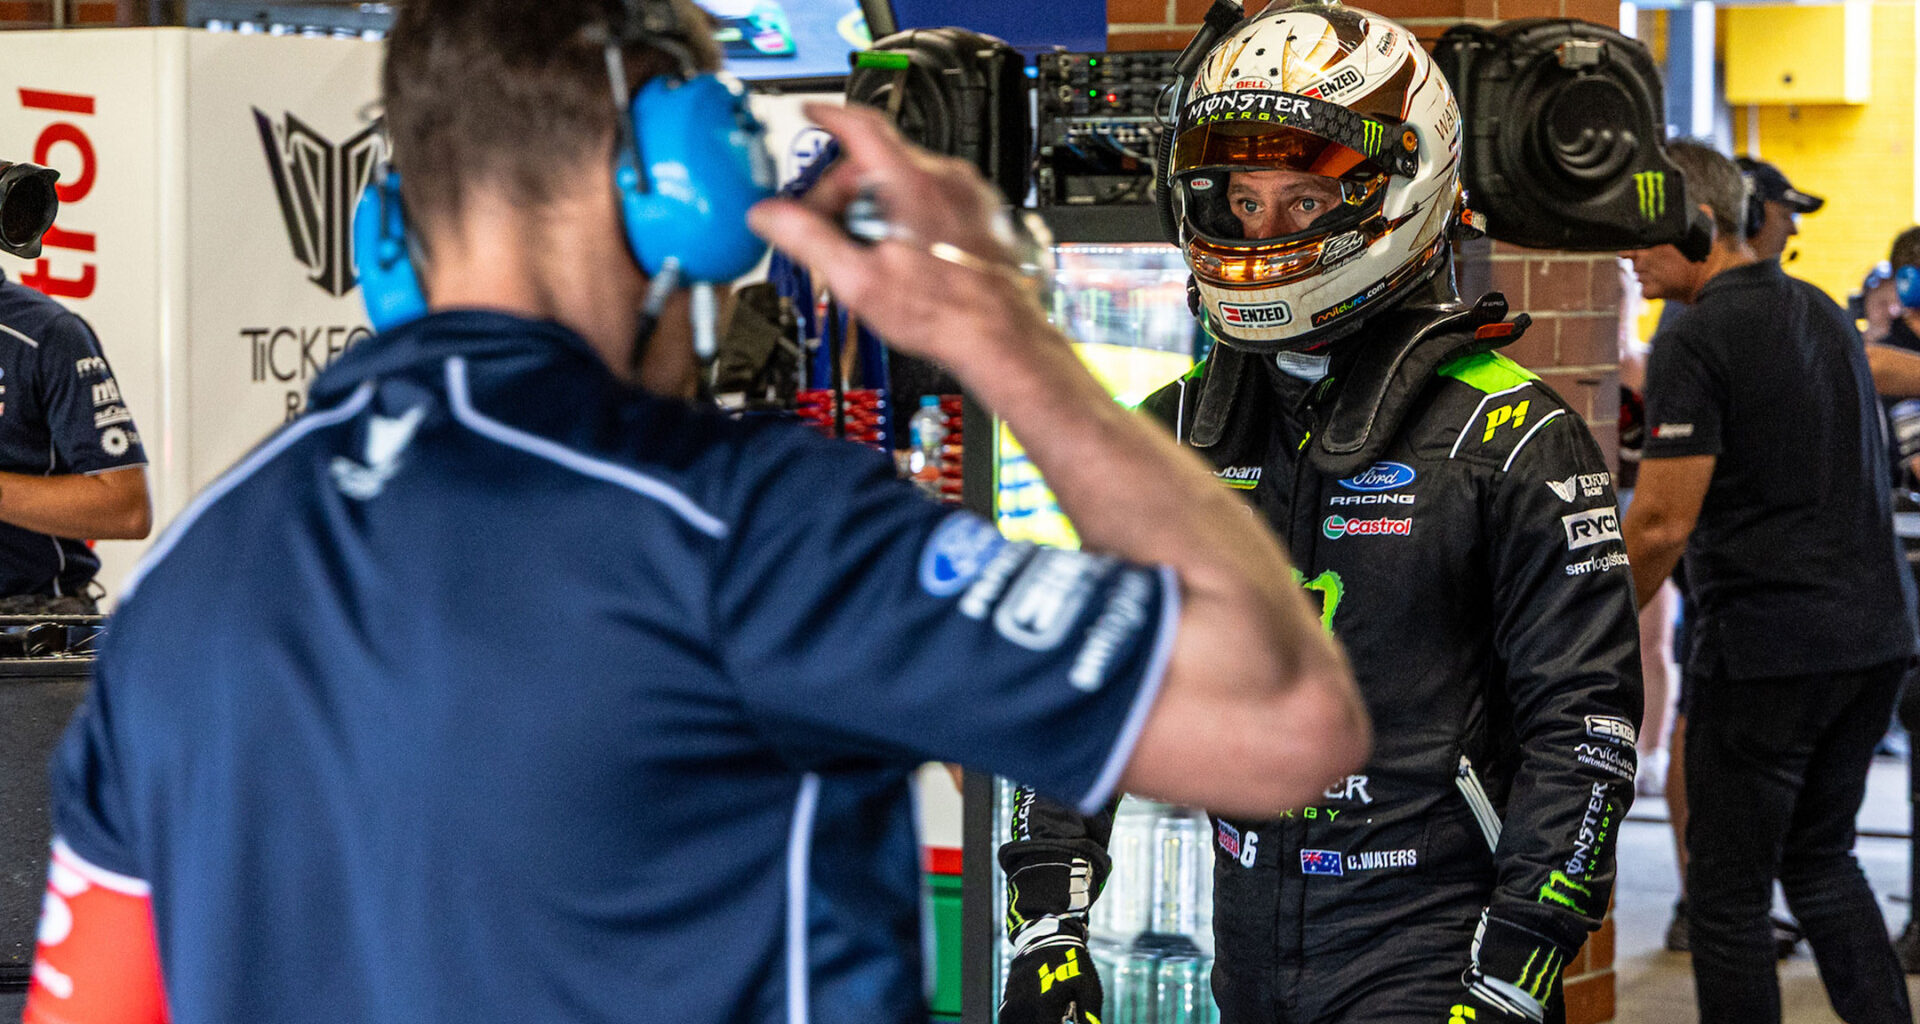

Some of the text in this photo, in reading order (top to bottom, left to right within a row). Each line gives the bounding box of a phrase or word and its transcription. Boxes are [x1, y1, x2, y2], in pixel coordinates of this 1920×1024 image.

[1235, 80, 1267, 89] BELL
[1318, 70, 1358, 98] ENZED
[1197, 111, 1288, 125] ENERGY
[1434, 97, 1458, 141] WAT
[18, 87, 97, 299] trol
[1239, 306, 1285, 322] ENZED
[239, 326, 374, 384] TICKF
[1482, 399, 1531, 443] P1
[1214, 466, 1263, 480] barn
[1353, 464, 1401, 486] Ford
[1329, 493, 1416, 506] RACING
[1346, 516, 1414, 536] Castrol
[1565, 781, 1609, 875] ONSTER
[1240, 830, 1259, 868] 6
[1346, 848, 1418, 871] C.WATERS
